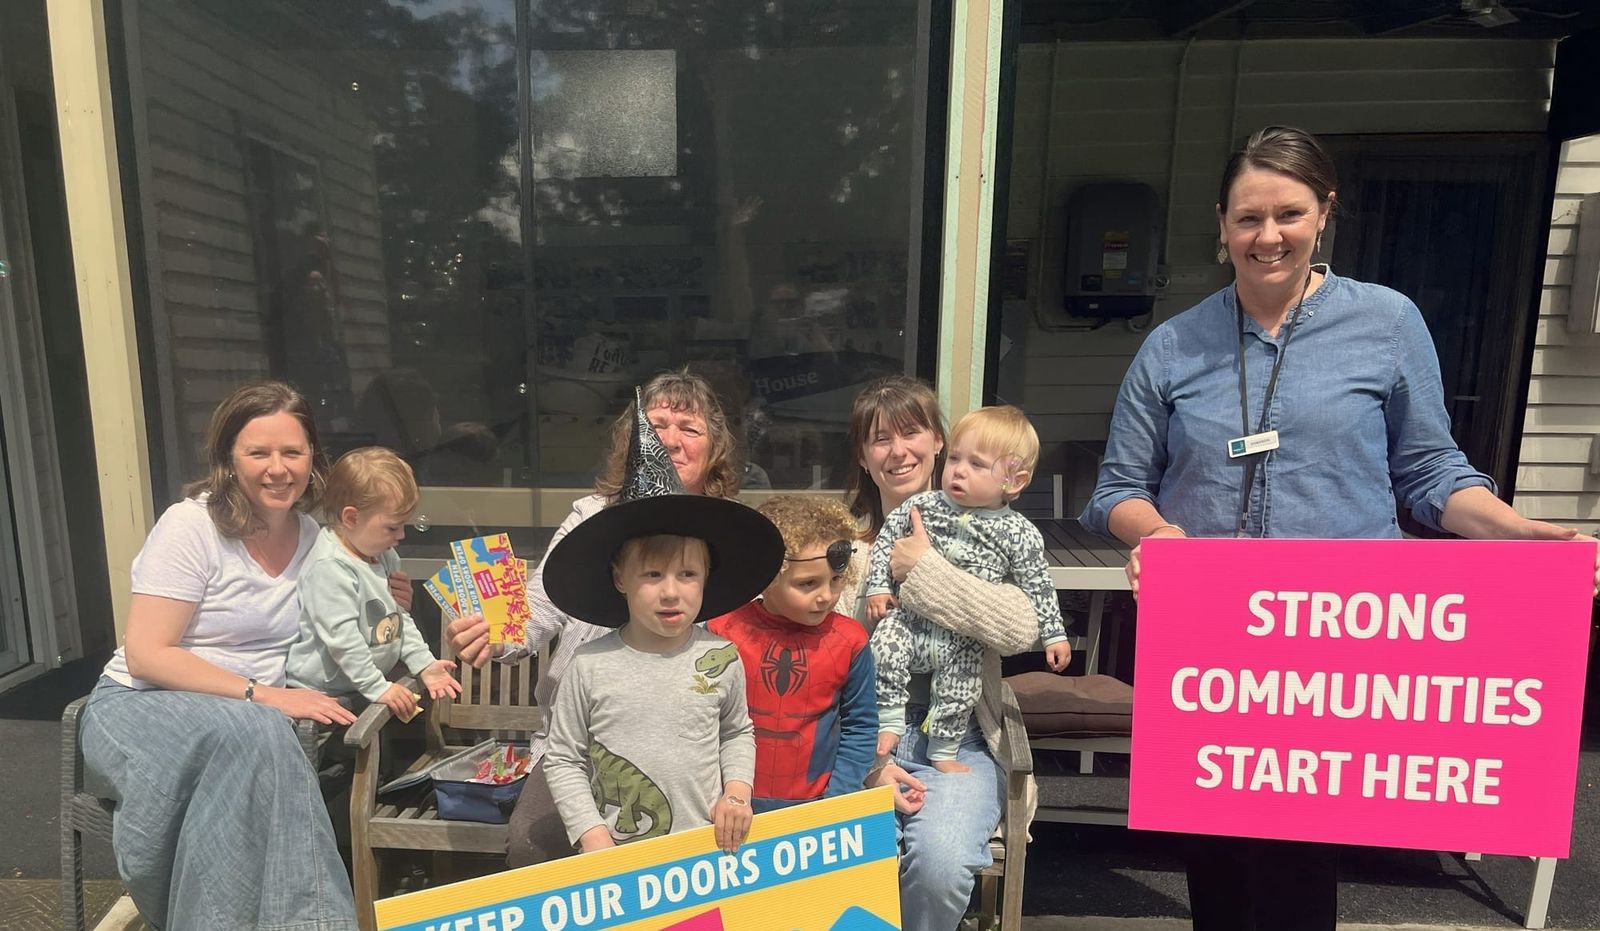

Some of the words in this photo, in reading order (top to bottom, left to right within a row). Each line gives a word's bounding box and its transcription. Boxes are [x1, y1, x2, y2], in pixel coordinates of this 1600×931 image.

[754, 370, 818, 395] House
[1246, 590, 1467, 642] STRONG
[1170, 666, 1544, 727] COMMUNITIES
[1195, 744, 1353, 797] START
[1362, 753, 1503, 806] HERE
[425, 906, 525, 931] EP
[541, 882, 625, 931] OUR
[638, 848, 761, 911] DOORS
[772, 824, 864, 877] OPEN
